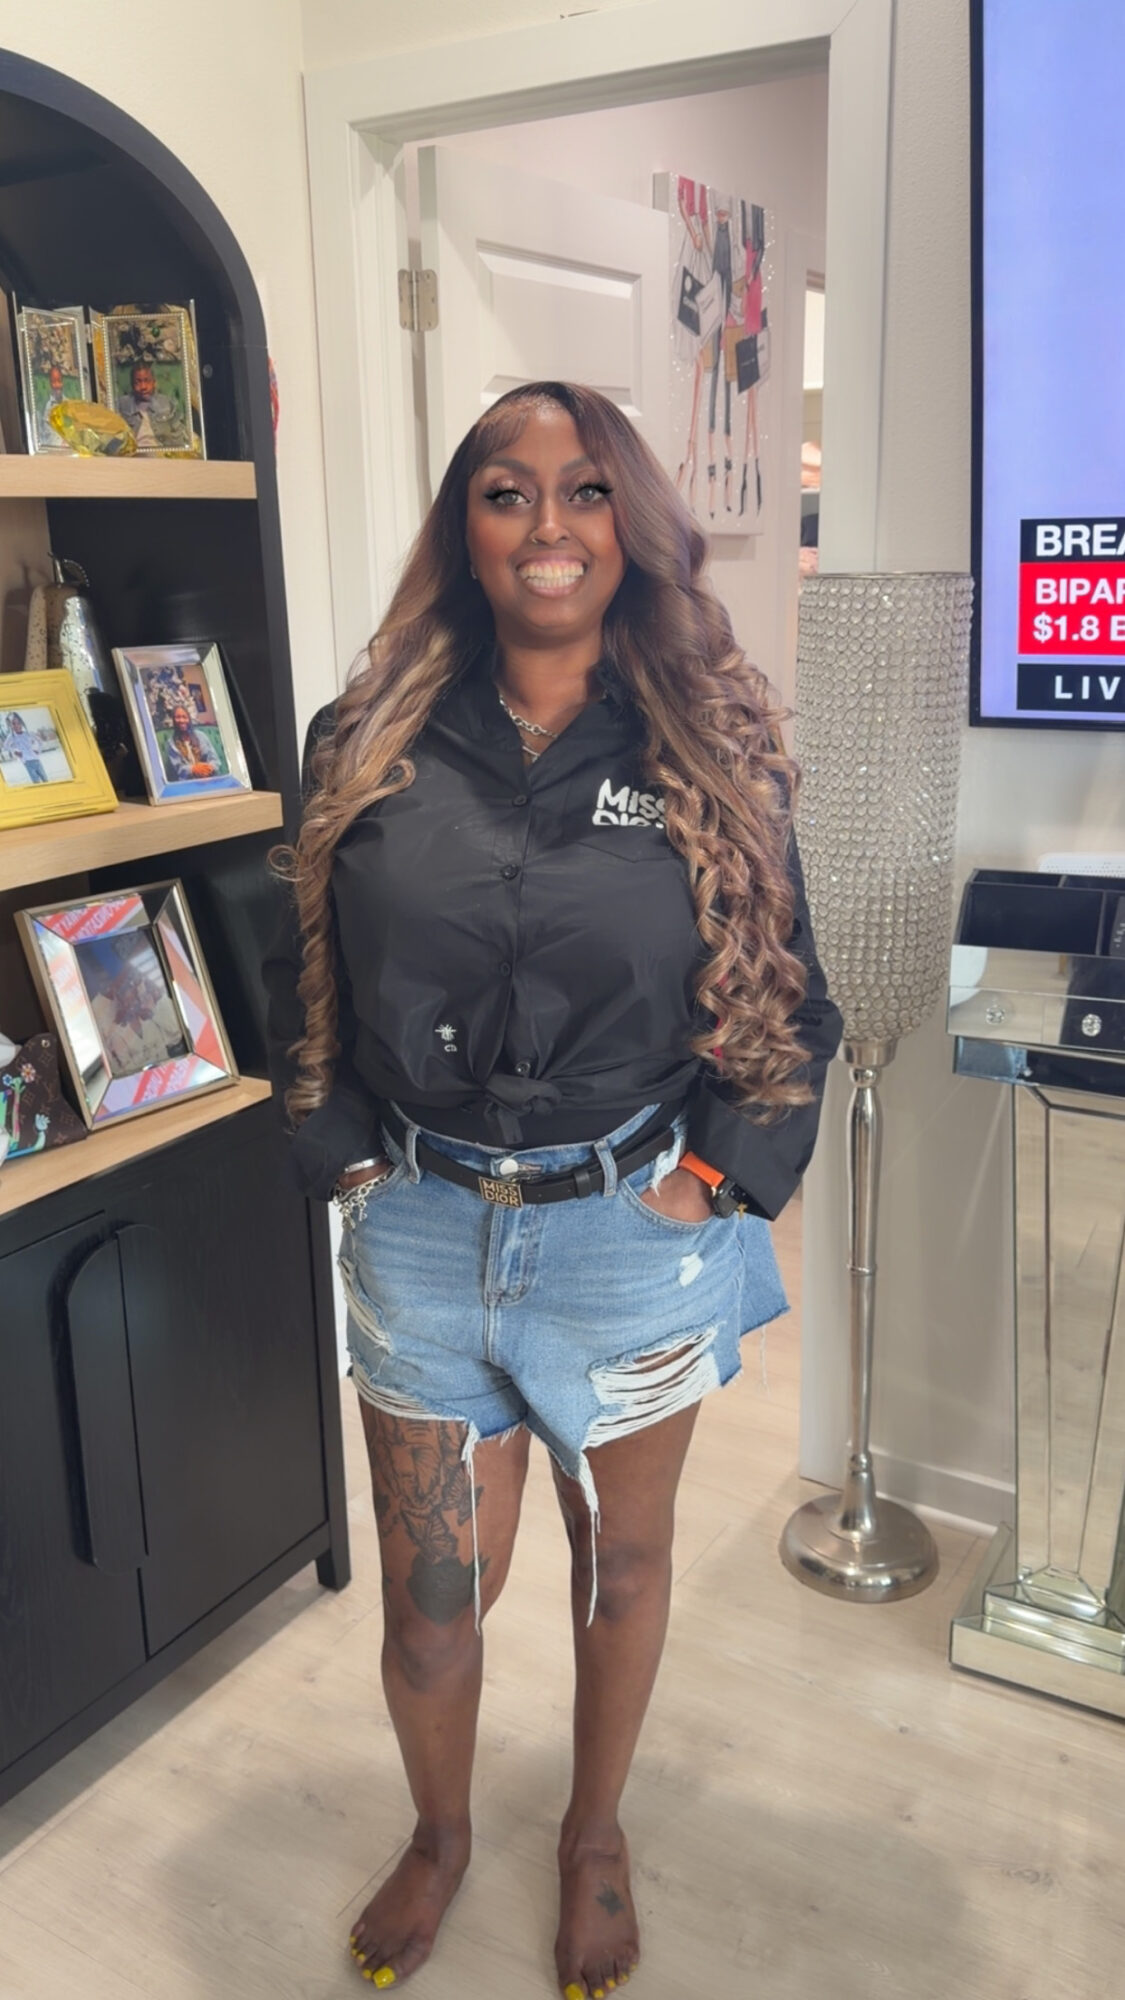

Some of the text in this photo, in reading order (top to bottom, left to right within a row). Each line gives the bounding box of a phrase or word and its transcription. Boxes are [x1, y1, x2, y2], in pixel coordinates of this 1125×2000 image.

[1033, 612, 1100, 643] $1.8
[482, 1180, 517, 1196] MISS
[485, 1190, 519, 1206] DIOR
